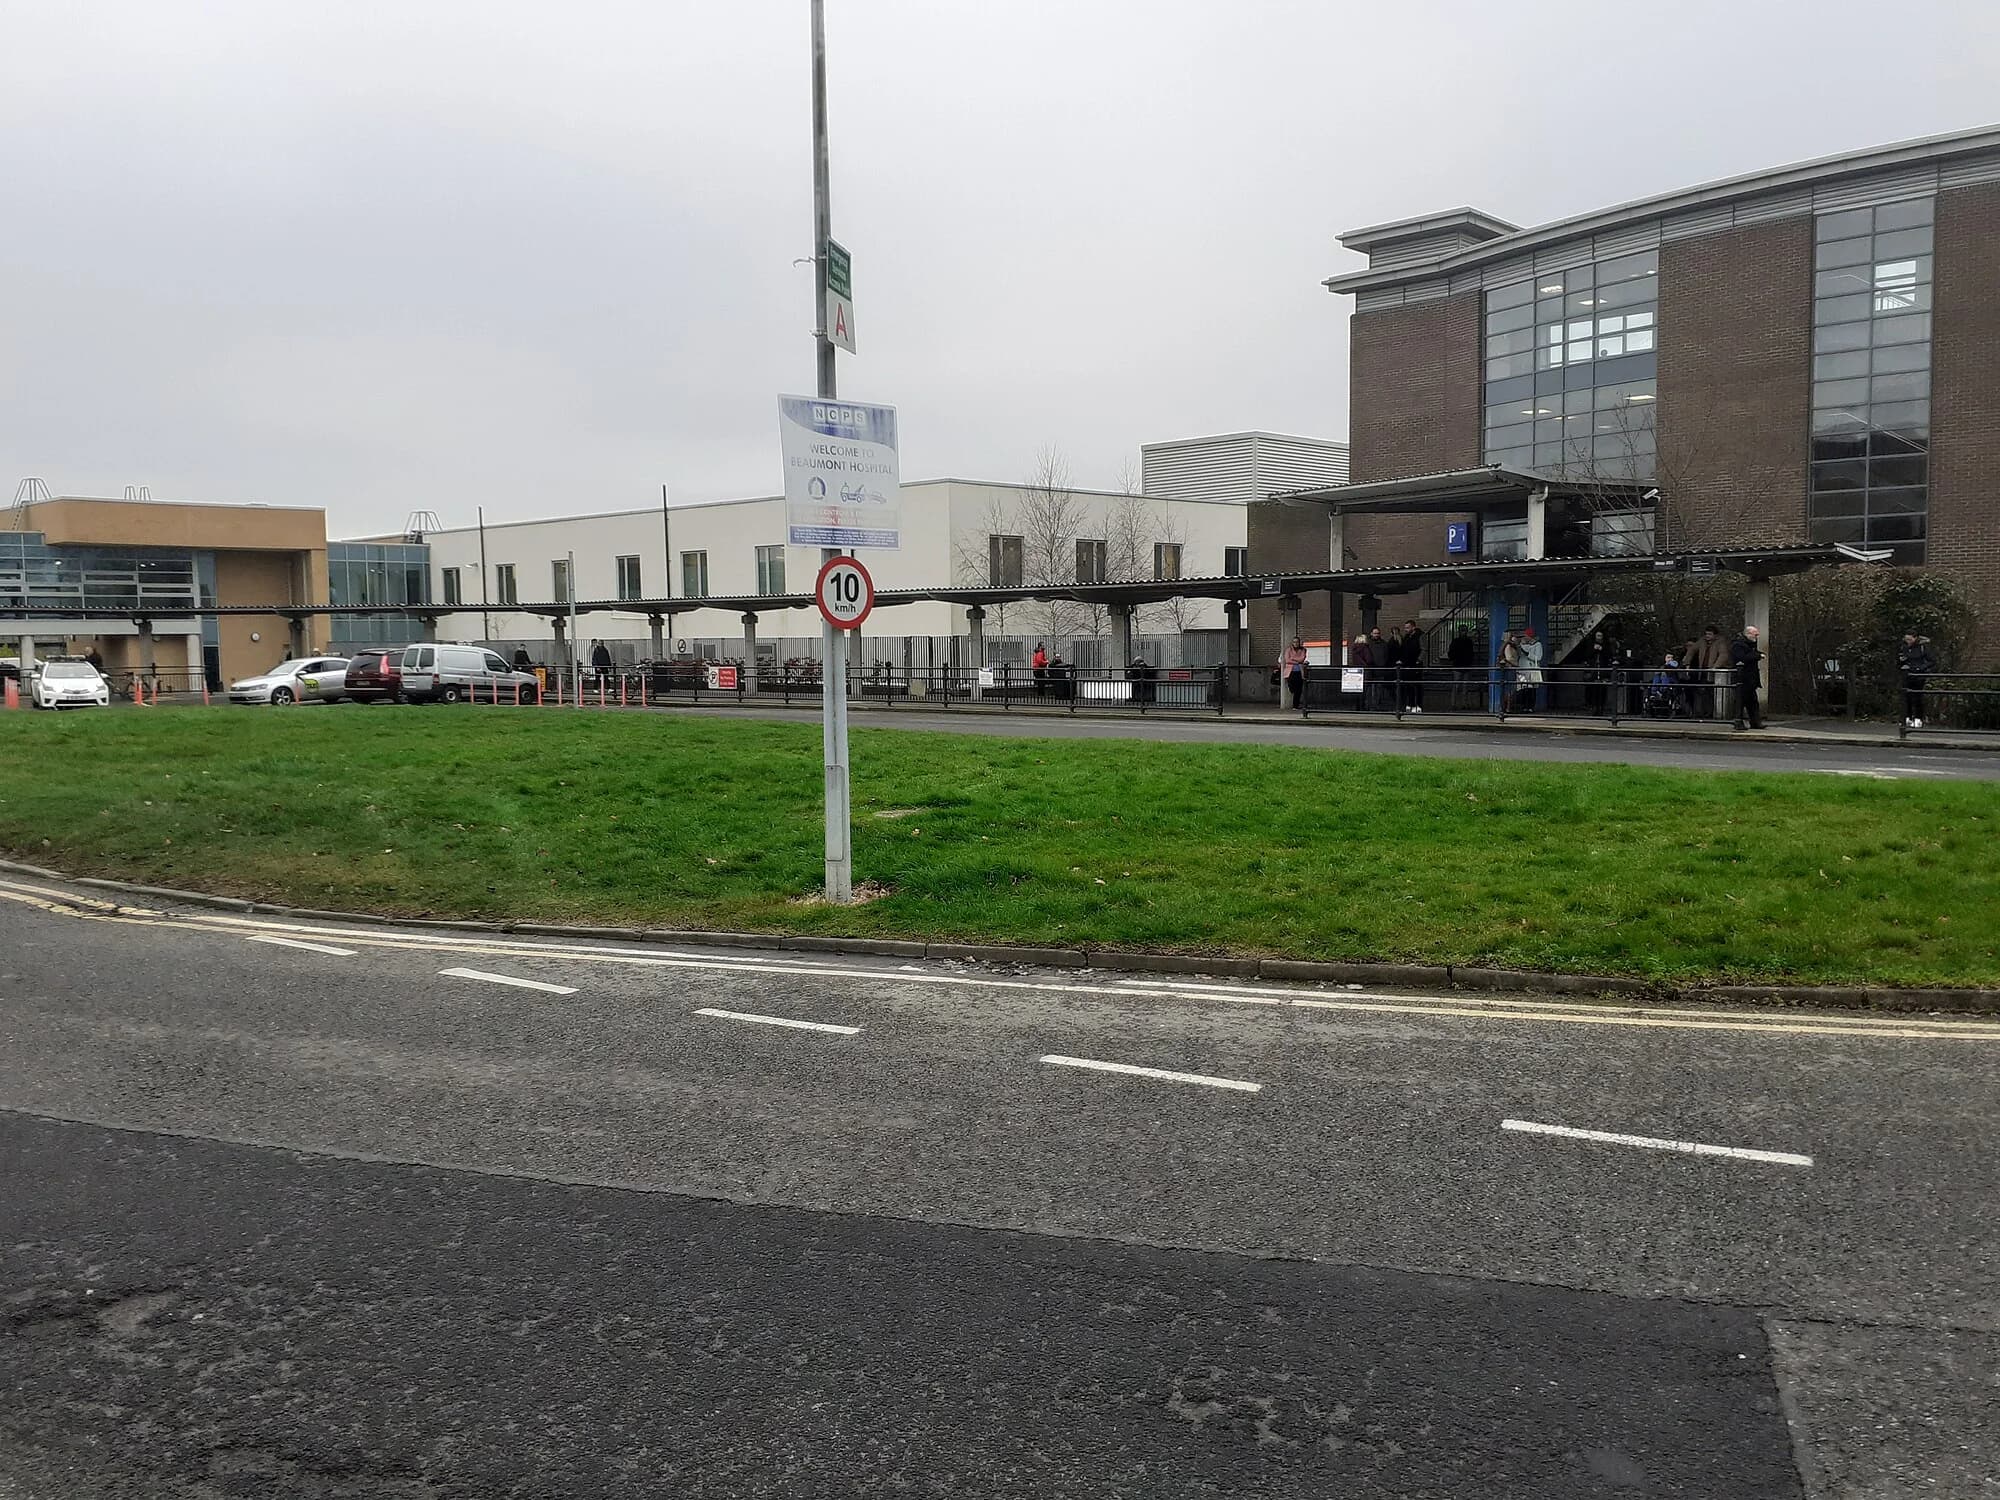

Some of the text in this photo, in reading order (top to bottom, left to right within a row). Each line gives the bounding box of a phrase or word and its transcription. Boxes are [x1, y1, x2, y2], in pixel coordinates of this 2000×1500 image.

[836, 302, 848, 341] A
[815, 408, 863, 422] NCPS
[810, 444, 859, 457] WELCOME
[791, 456, 893, 474] BEAUMONT HOSPITAL
[830, 572, 859, 602] 10
[835, 603, 856, 613] km/h
